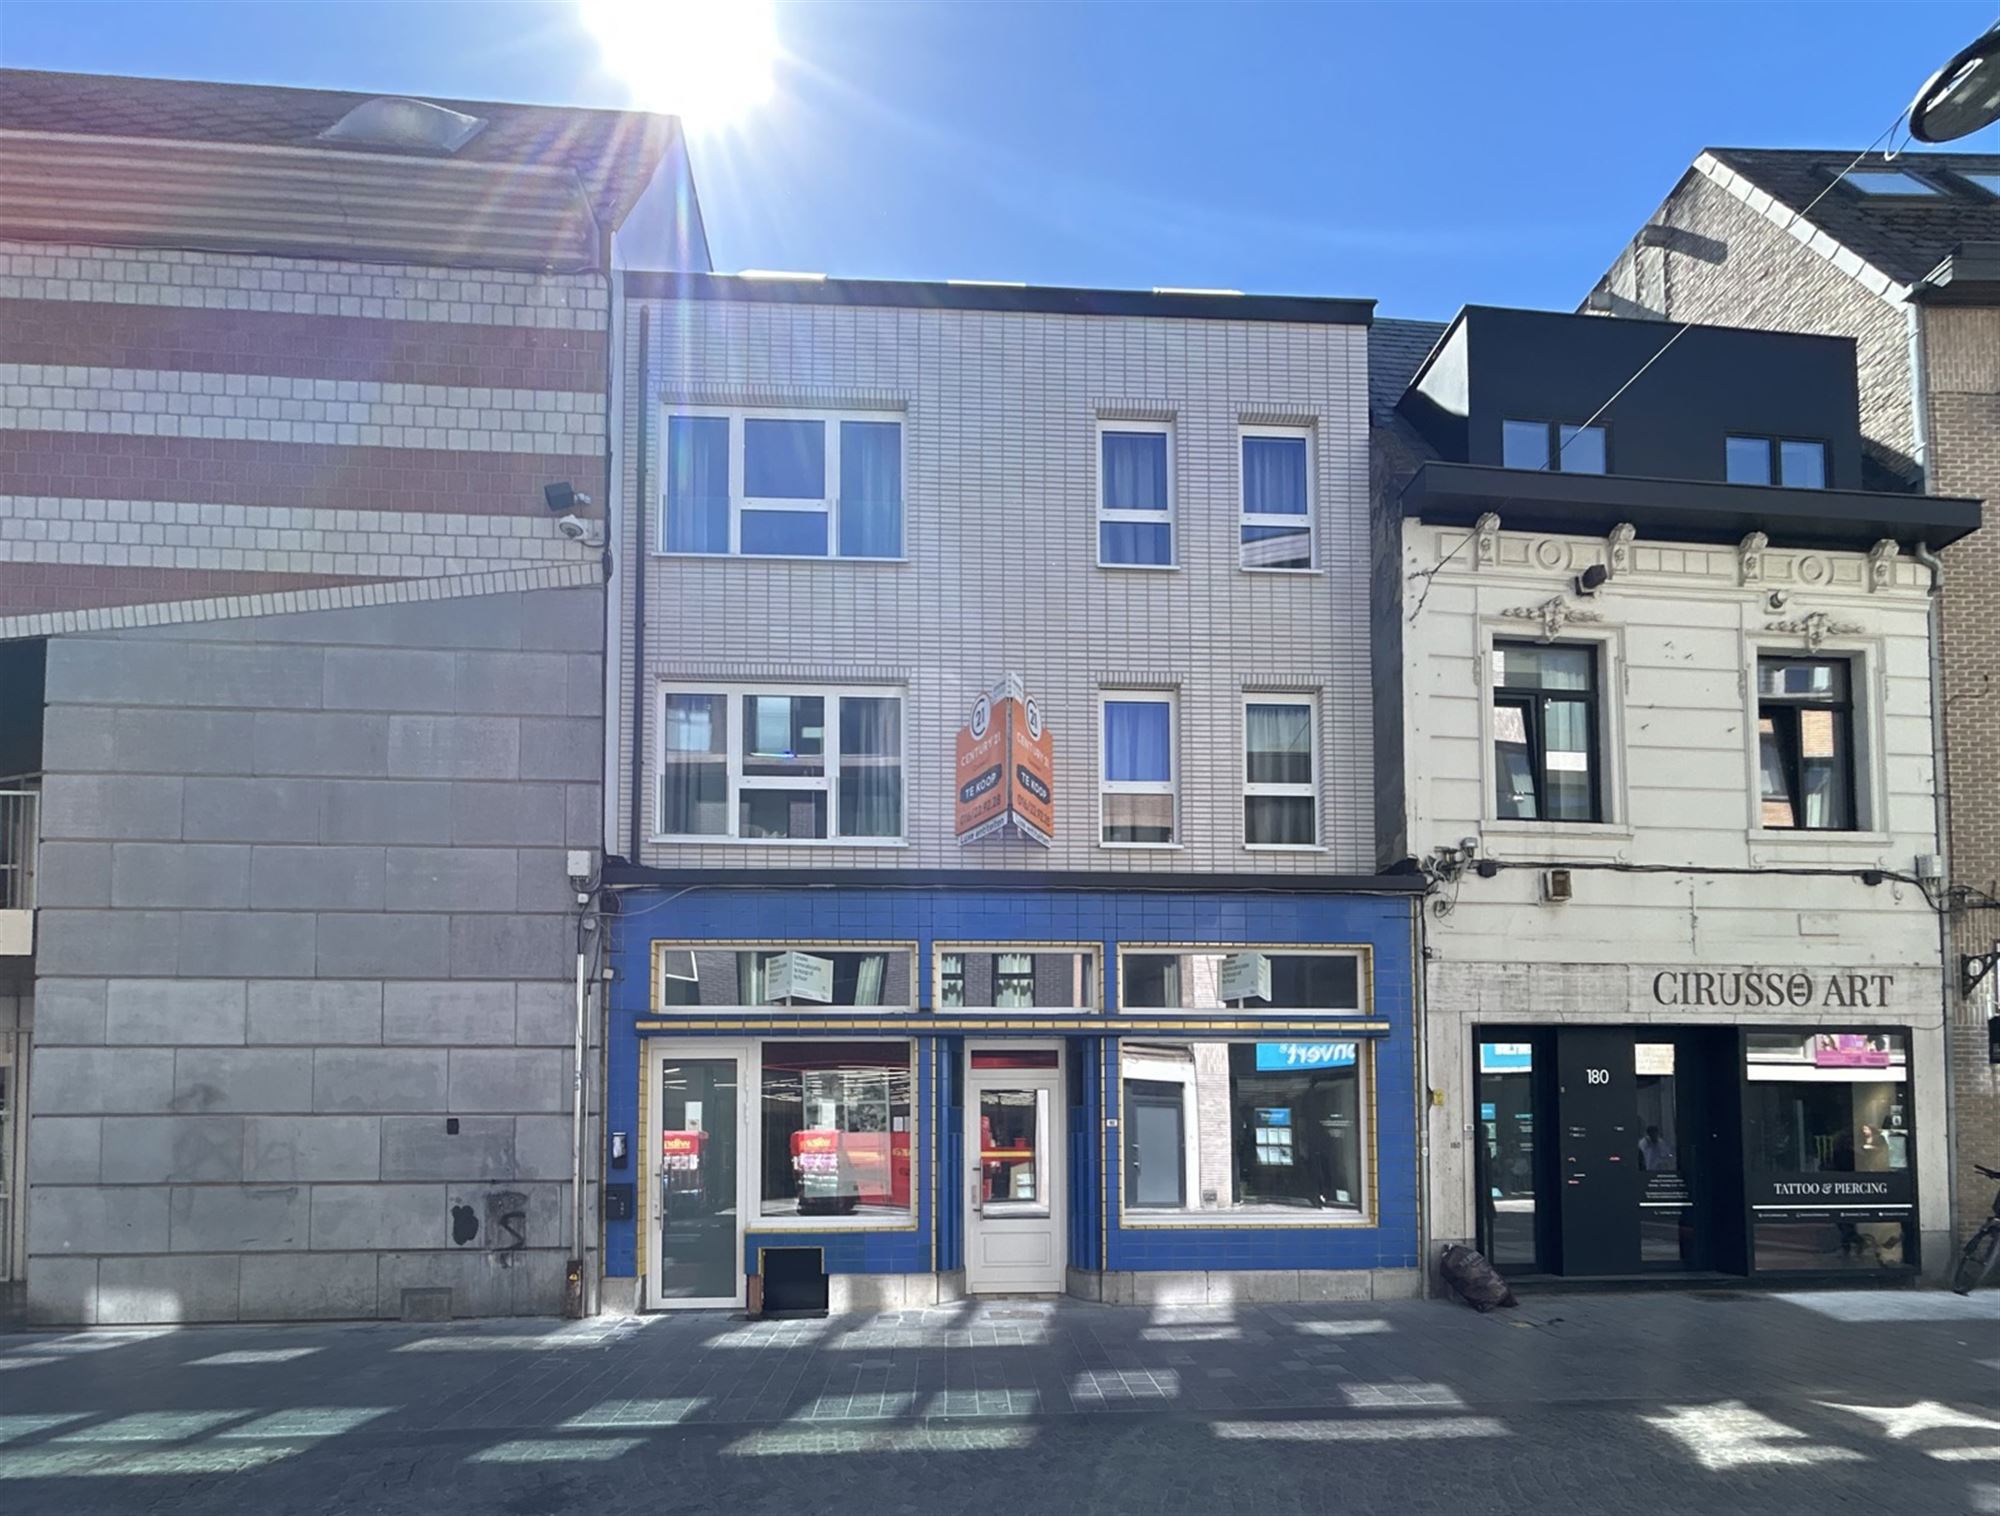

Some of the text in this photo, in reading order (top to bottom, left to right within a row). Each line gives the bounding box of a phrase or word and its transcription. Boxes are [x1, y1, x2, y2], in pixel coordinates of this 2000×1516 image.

[961, 738, 993, 767] CENTURY
[965, 772, 997, 799] TE KOOP
[1020, 772, 1047, 798] TE KOOP
[1653, 972, 1813, 1007] CIRUSSO
[1822, 974, 1894, 1007] ART
[1586, 1069, 1609, 1084] 180
[1773, 1182, 1887, 1195] TATTOO & PIERCING
